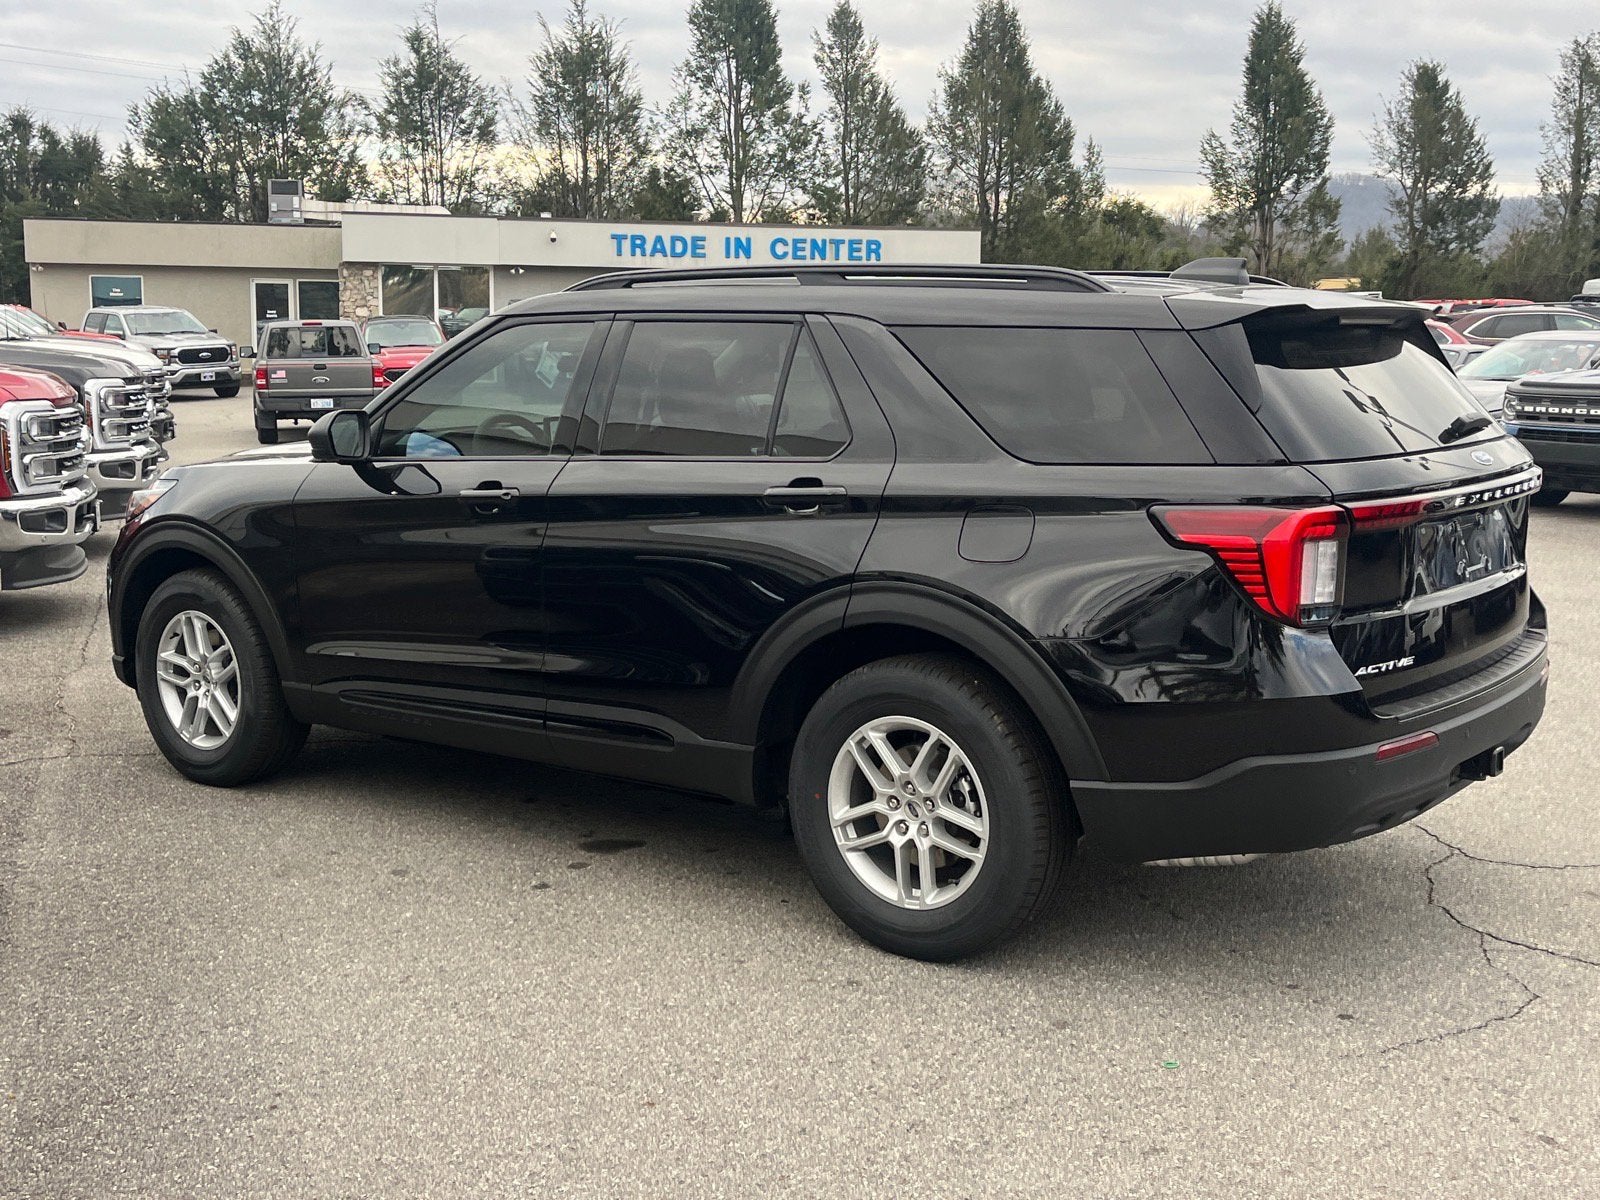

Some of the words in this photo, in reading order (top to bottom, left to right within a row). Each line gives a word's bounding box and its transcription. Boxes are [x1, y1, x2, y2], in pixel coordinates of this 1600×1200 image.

[610, 233, 707, 258] TRADE
[725, 236, 752, 259] IN
[770, 237, 882, 261] CENTER
[1523, 405, 1600, 415] BRONCO
[1353, 655, 1416, 677] ACTIVE
